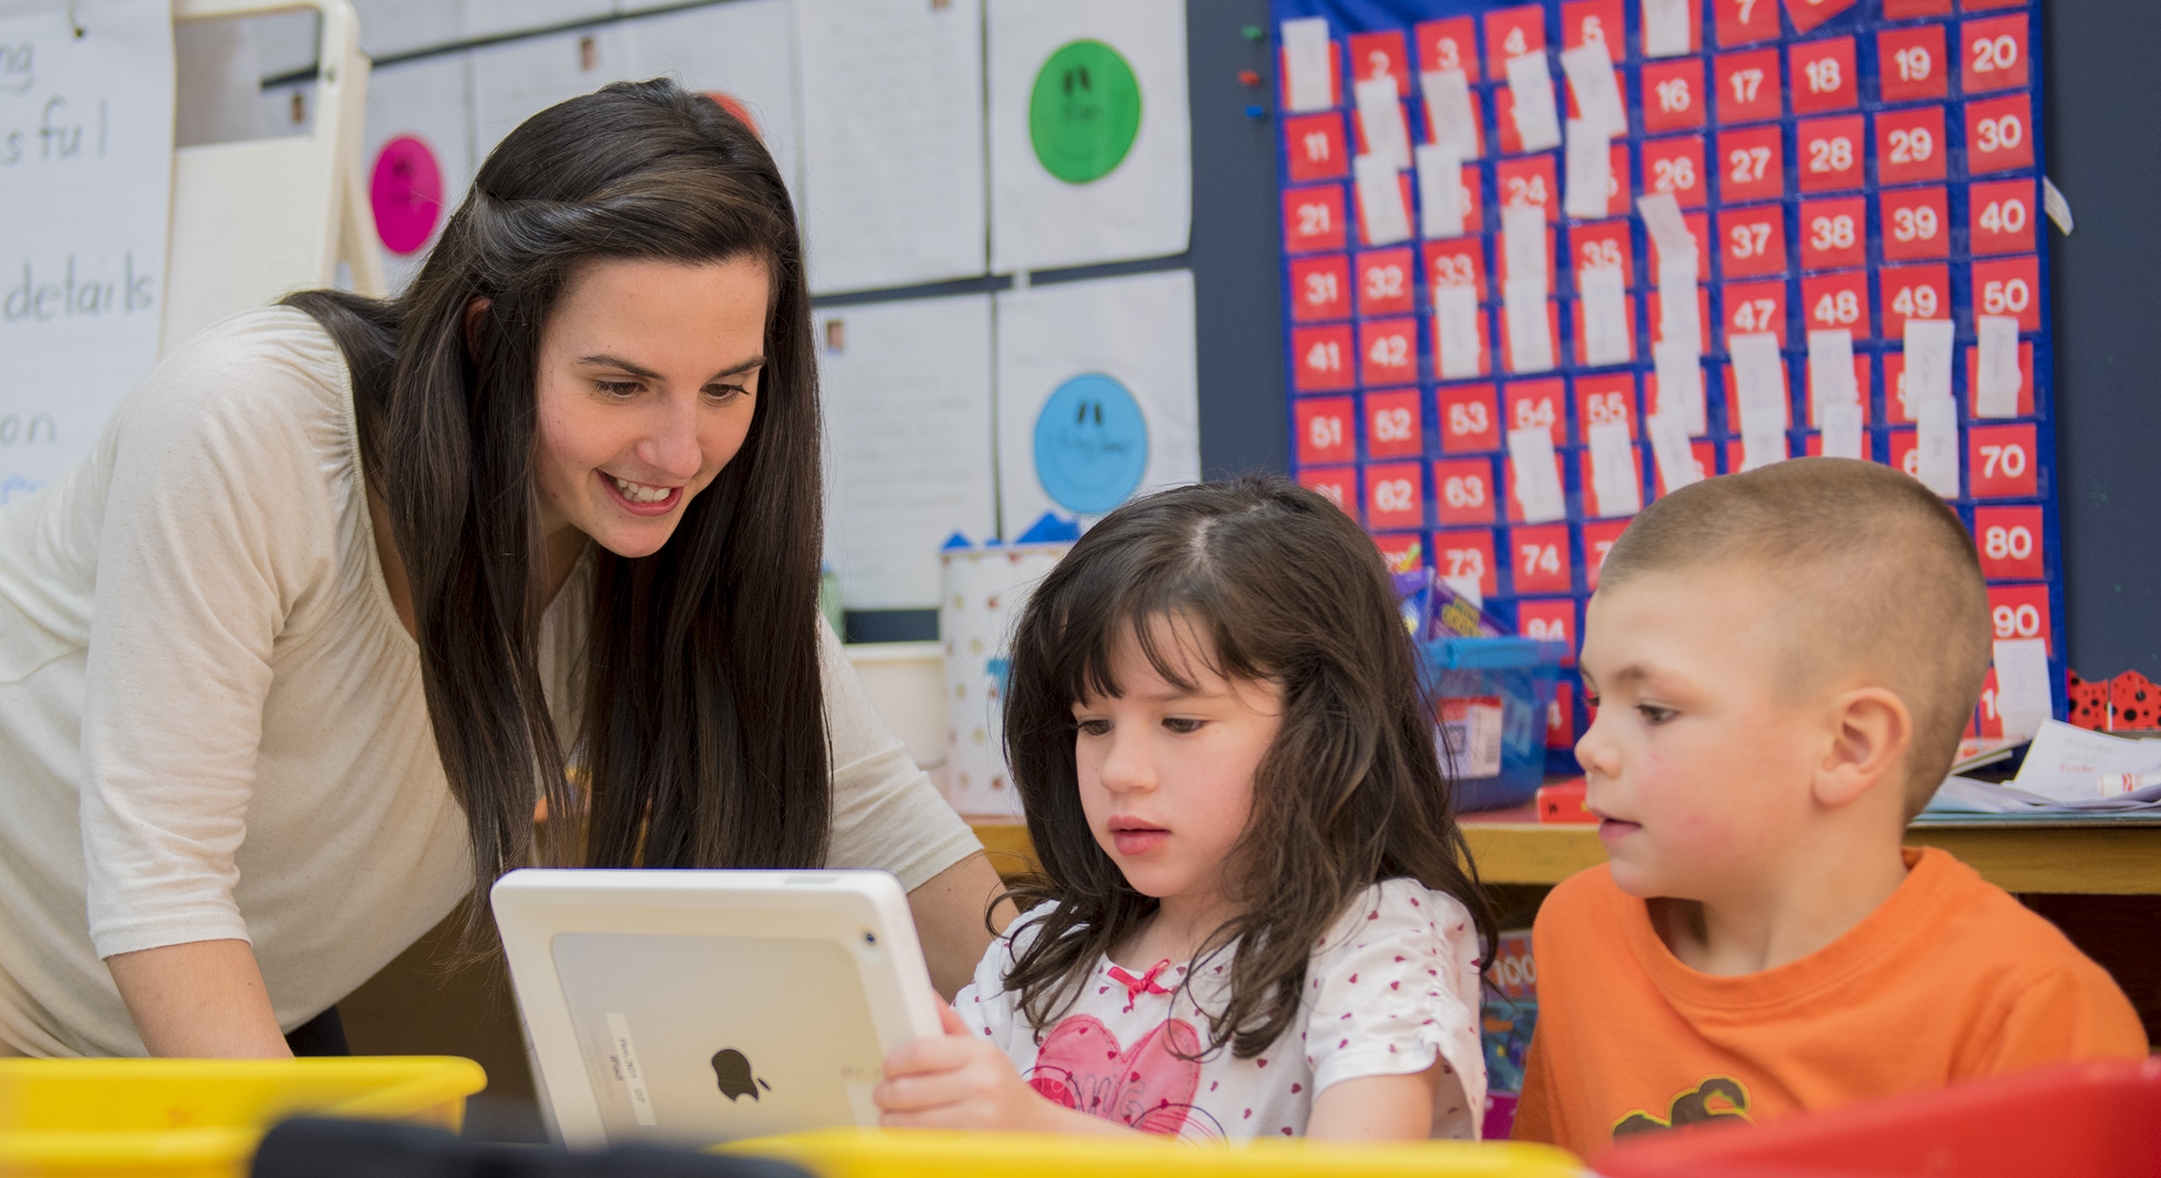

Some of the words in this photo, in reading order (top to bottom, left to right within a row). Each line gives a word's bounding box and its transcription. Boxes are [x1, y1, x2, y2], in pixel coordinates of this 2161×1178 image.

[1504, 28, 1527, 56] 4
[1582, 16, 1605, 46] 5
[1369, 51, 1391, 79] 2
[1437, 38, 1461, 70] 3
[1894, 46, 1931, 81] 19
[1972, 34, 2018, 73] 20
[1729, 68, 1764, 104] 17
[1804, 57, 1842, 93] 18
[1656, 78, 1691, 112] 16
[1304, 132, 1329, 161] 11
[1888, 127, 1933, 165] 29
[1977, 114, 2022, 153] 30
[1730, 146, 1772, 184] 27
[1809, 136, 1853, 173] 28
[1507, 175, 1548, 206] 24
[1653, 157, 1696, 192] 26
[1298, 203, 1331, 236] 21
[1811, 214, 1855, 251] 38
[1893, 205, 1938, 242] 39
[1979, 198, 2026, 234] 40
[1581, 239, 1623, 271] 35
[1731, 222, 1772, 259] 37
[4, 249, 154, 322] details
[1366, 265, 1404, 299] 32
[1435, 253, 1476, 285] 33
[1305, 272, 1338, 306] 31
[1892, 285, 1938, 318] 49
[1983, 278, 2029, 315] 50
[1733, 299, 1776, 336] 47
[1813, 290, 1860, 326] 48
[1307, 342, 1341, 371] 41
[1369, 334, 1408, 367] 42
[1374, 407, 1412, 442] 52
[1448, 401, 1489, 436] 53
[1515, 397, 1555, 428] 54
[1587, 391, 1626, 424] 55
[1310, 416, 1342, 449] 51
[1979, 444, 2026, 479] 70
[1374, 479, 1413, 512] 62
[1444, 475, 1485, 509] 63
[1521, 544, 1561, 575] 74
[1985, 525, 2033, 560] 80
[1446, 548, 1485, 577] 73
[1992, 604, 2040, 637] 90
